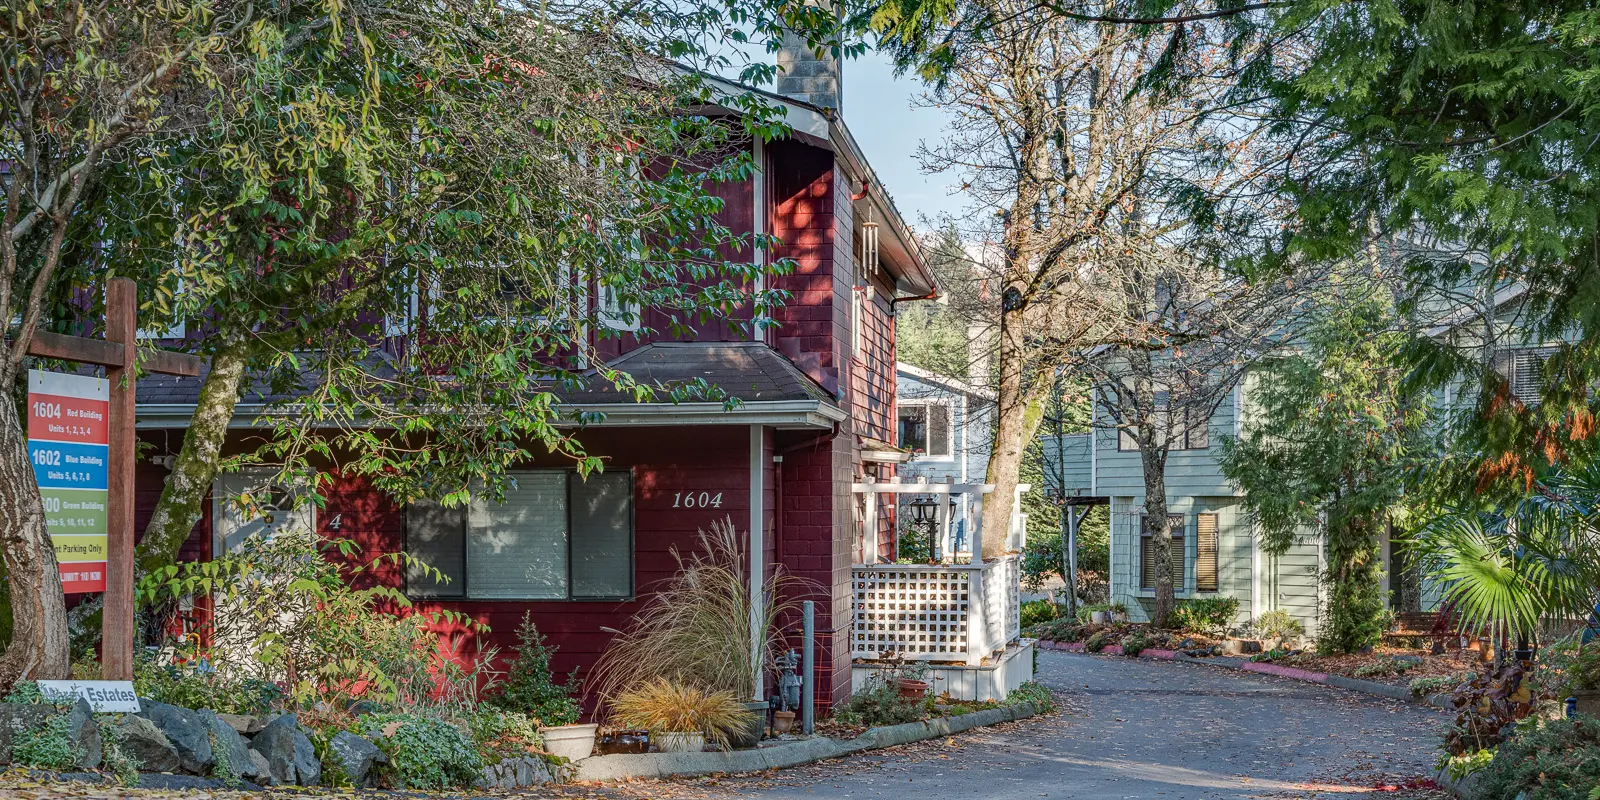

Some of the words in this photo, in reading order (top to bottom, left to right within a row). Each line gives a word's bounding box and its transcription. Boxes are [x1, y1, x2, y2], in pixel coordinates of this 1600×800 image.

[33, 402, 61, 419] 1604
[67, 409, 78, 417] Red
[80, 410, 103, 421] Building
[48, 424, 64, 433] Units
[86, 427, 91, 435] 4
[32, 449, 60, 465] 1602
[65, 455, 79, 463] Blue
[80, 456, 103, 466] Building
[48, 471, 64, 480] Units
[672, 491, 723, 508] 1604
[63, 501, 80, 509] Green
[81, 502, 104, 512] Building
[46, 518, 59, 526] nits
[330, 513, 342, 529] 4
[1299, 536, 1319, 545] 600
[63, 544, 87, 554] Parking
[88, 544, 102, 554] Only
[86, 687, 135, 702] Estates
